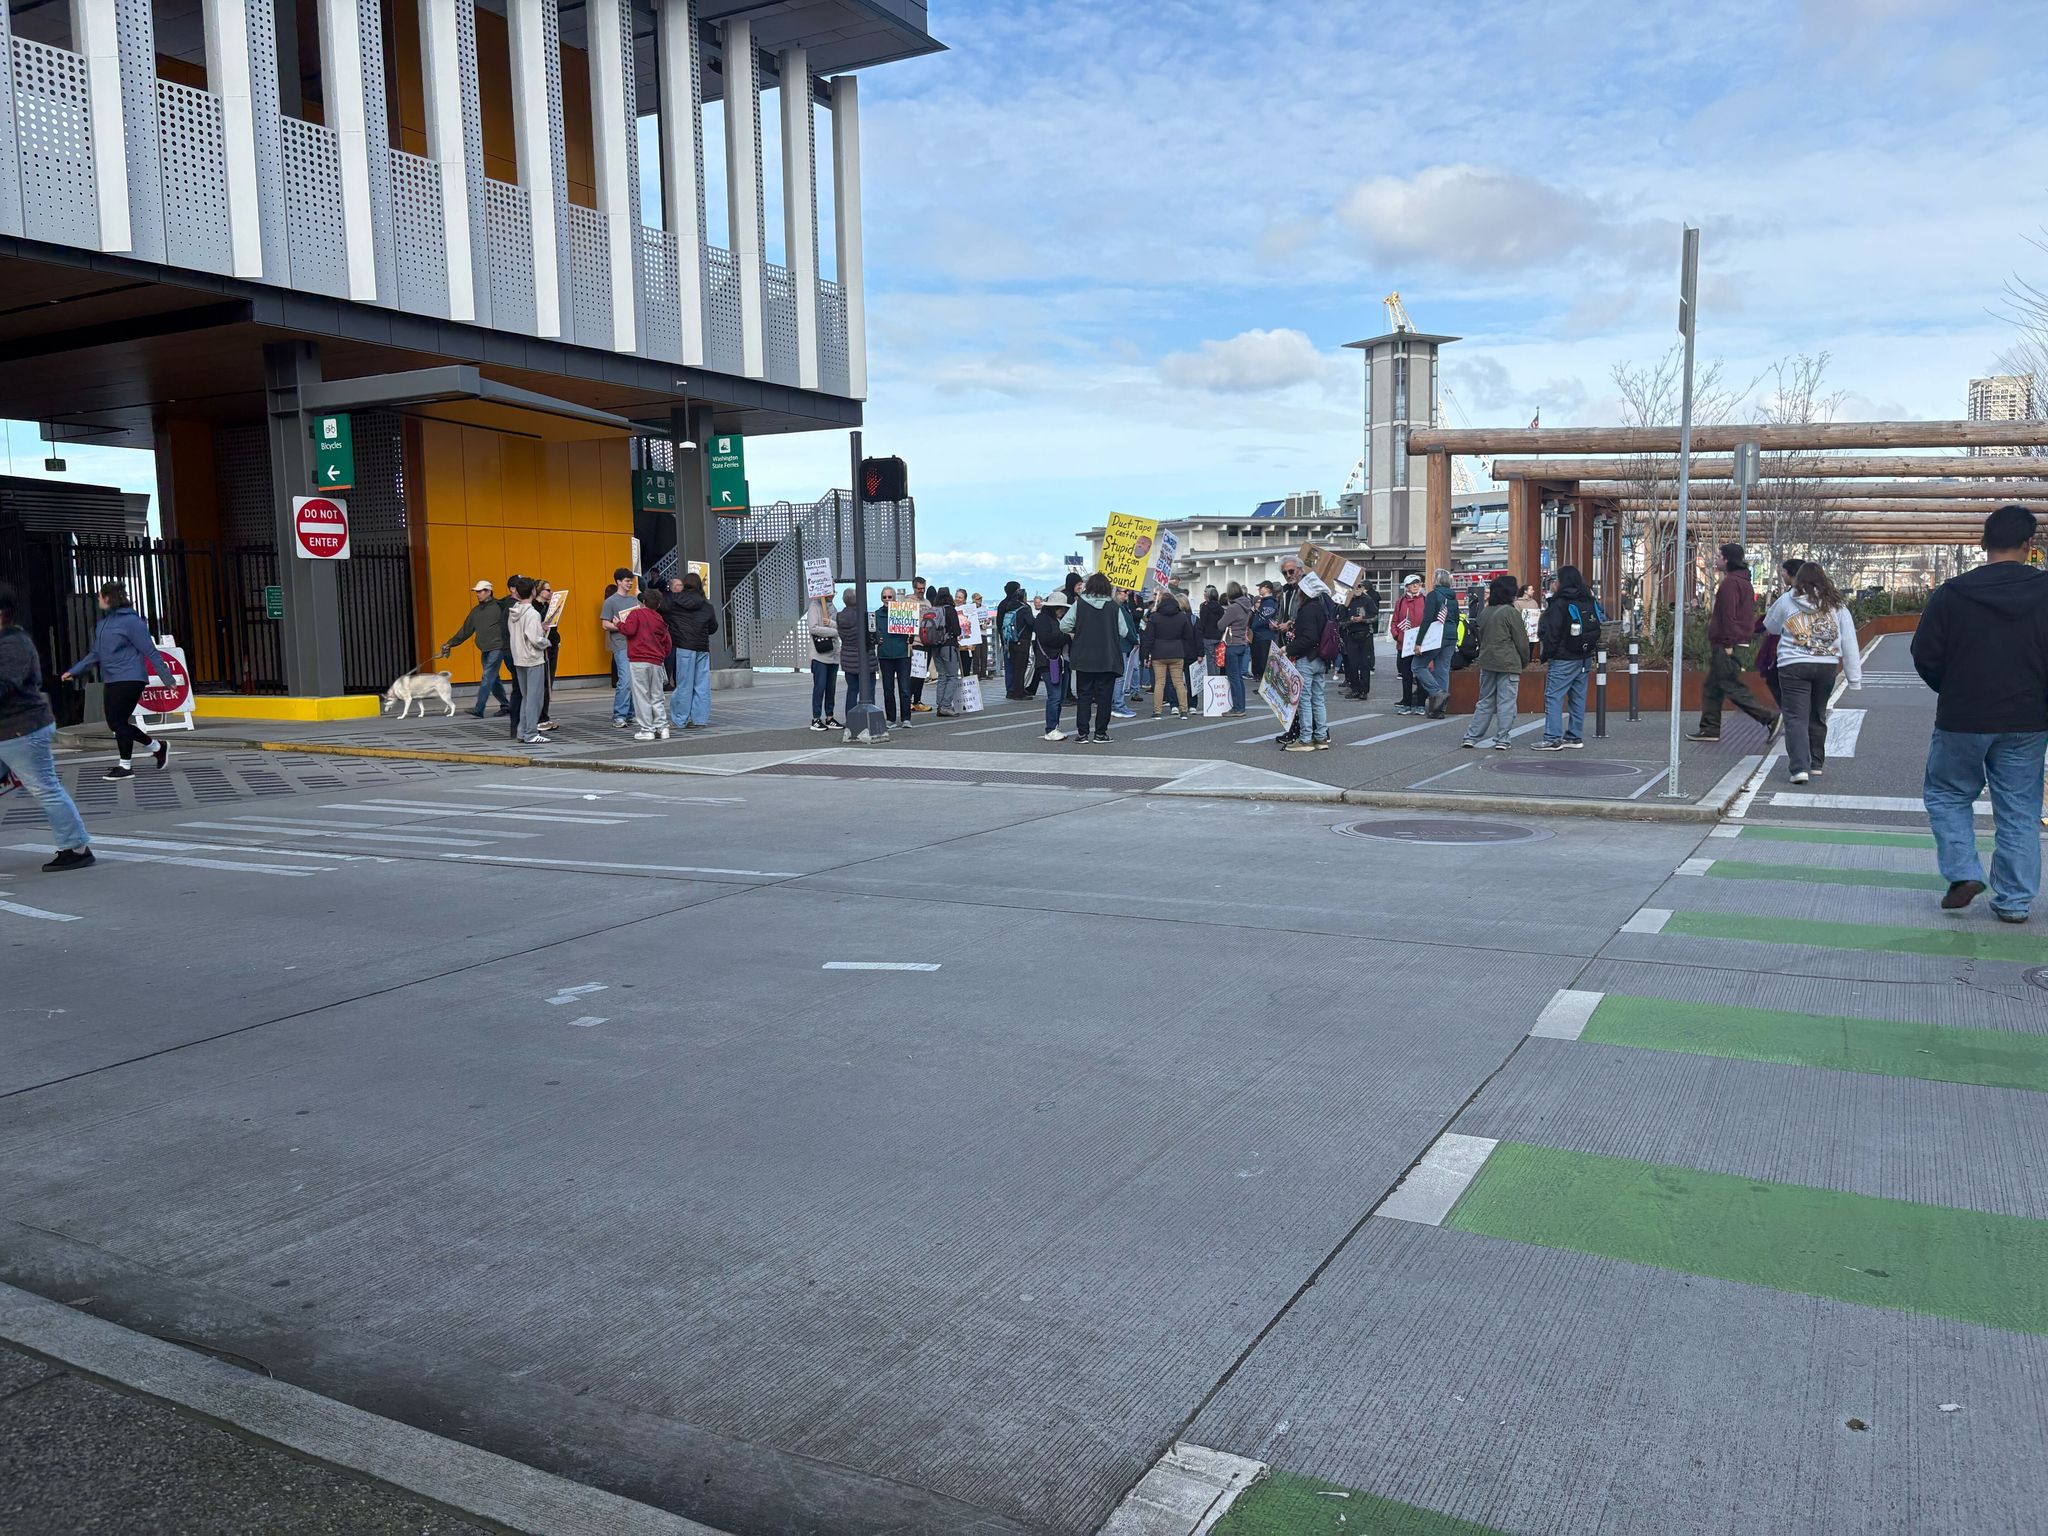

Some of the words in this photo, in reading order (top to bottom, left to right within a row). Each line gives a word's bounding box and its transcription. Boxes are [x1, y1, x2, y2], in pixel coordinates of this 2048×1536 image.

[320, 442, 342, 450] Bicycles
[304, 508, 317, 518] DO
[320, 509, 337, 519] NOT
[1112, 515, 1133, 528] Duct
[1134, 519, 1152, 533] Tape
[1129, 531, 1138, 540] fix
[309, 537, 339, 547] ENTER
[1103, 535, 1136, 557] Stupid
[1104, 551, 1115, 560] but
[1117, 554, 1125, 562] it
[1126, 558, 1140, 566] can
[1105, 561, 1133, 575] Muffle
[1107, 572, 1138, 588] Sound
[890, 601, 917, 610] IMPEACH
[889, 609, 913, 618] REMOVE
[889, 616, 919, 628] PROSECUTE
[141, 689, 179, 701] ENTER
